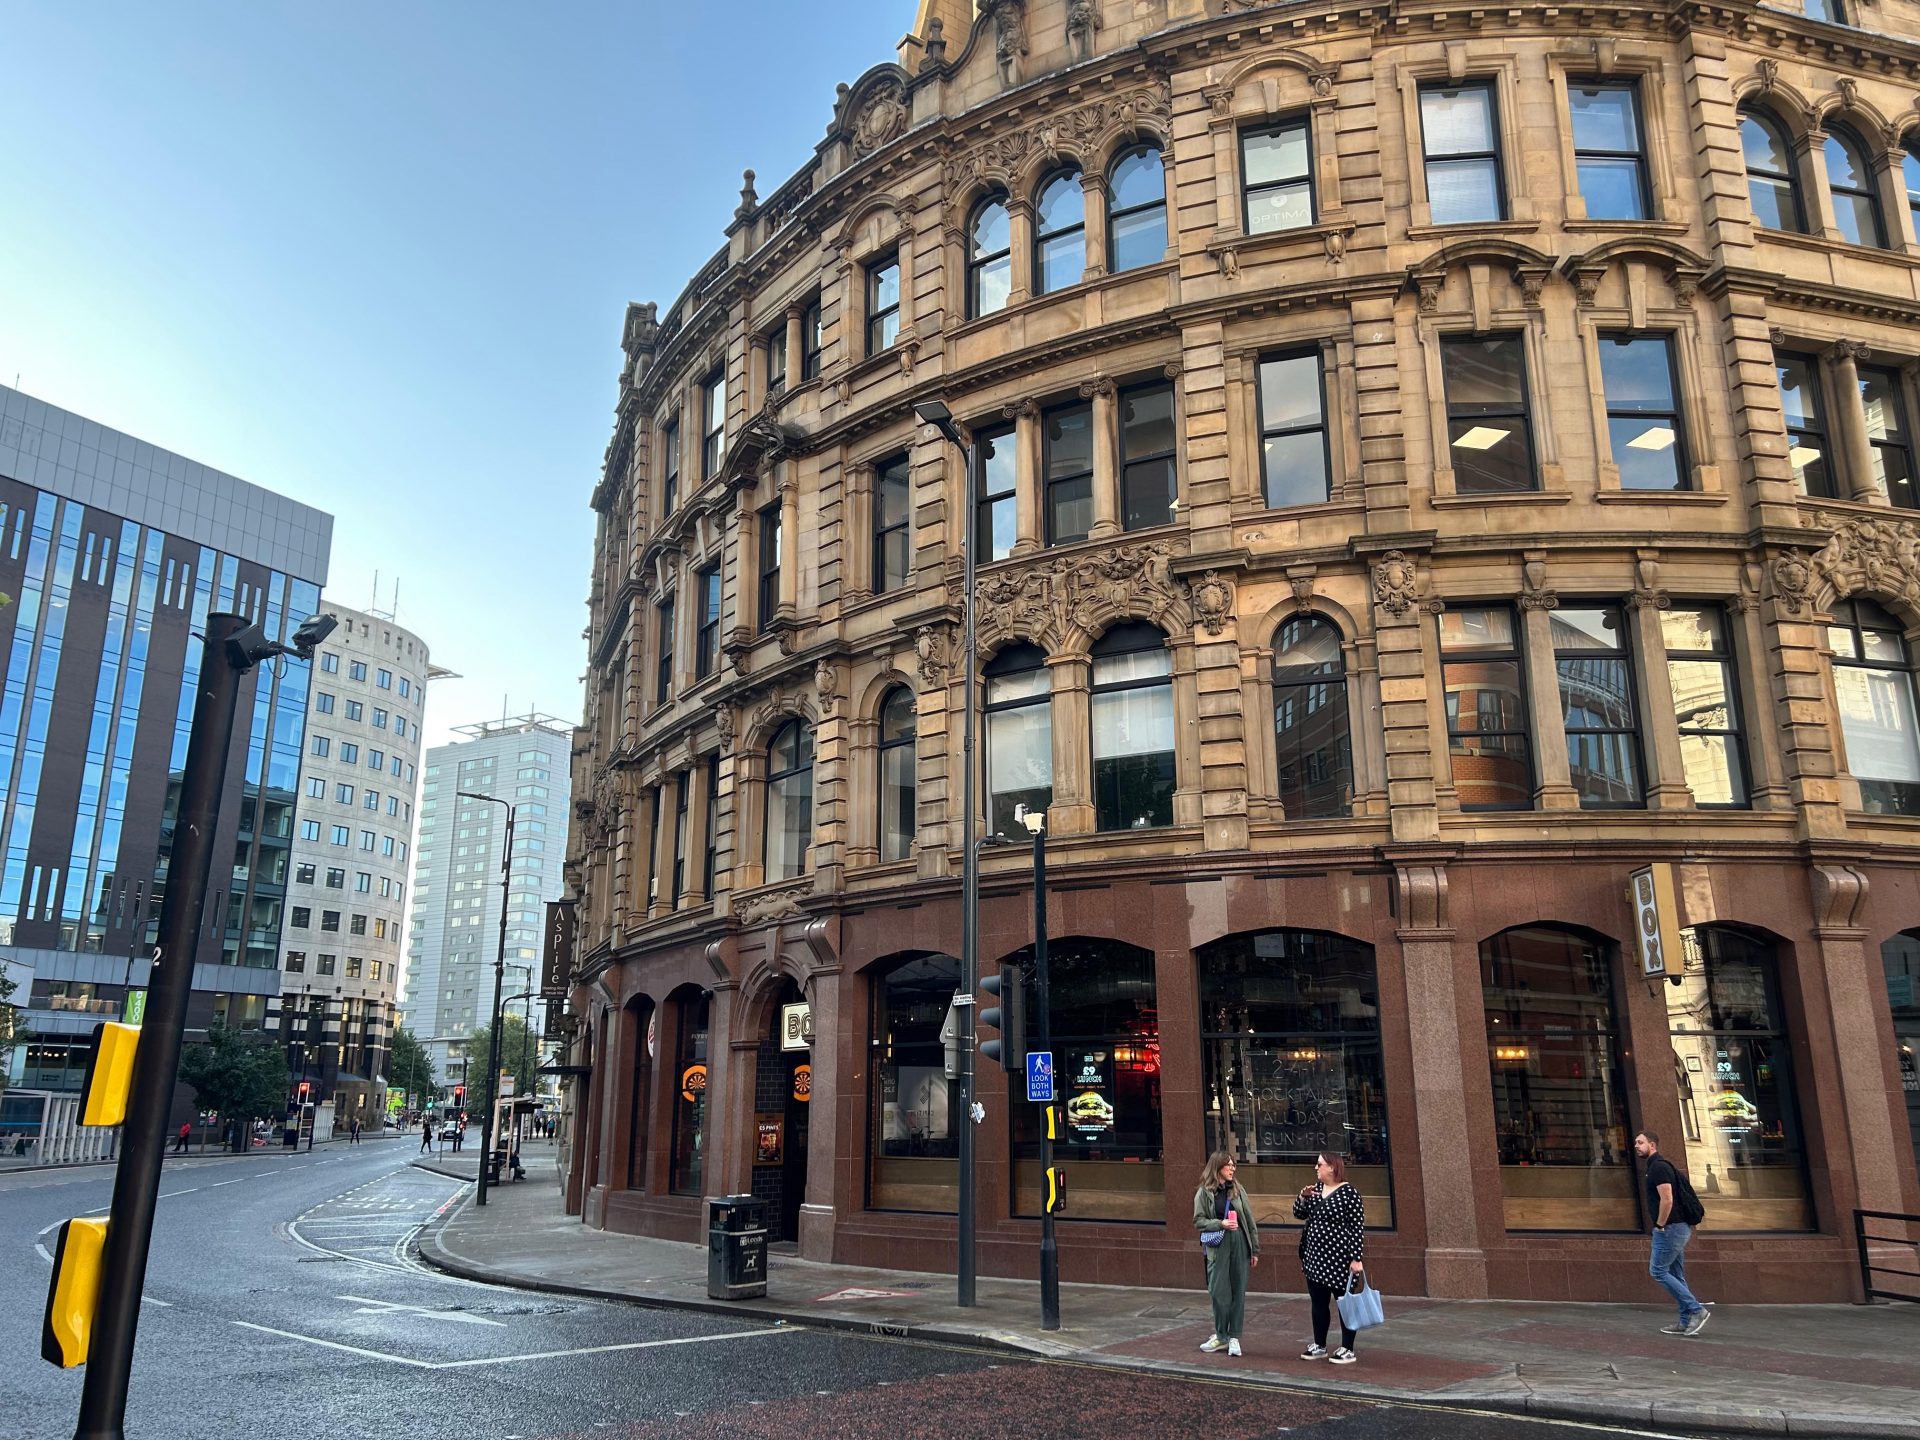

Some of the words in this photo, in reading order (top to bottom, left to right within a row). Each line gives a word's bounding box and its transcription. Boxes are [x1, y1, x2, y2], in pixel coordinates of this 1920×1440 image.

[1637, 875, 1661, 970] BOX
[551, 906, 565, 984] Aspire
[787, 1012, 811, 1040] BO
[1082, 1066, 1096, 1075] £9
[1716, 1062, 1732, 1072] £9
